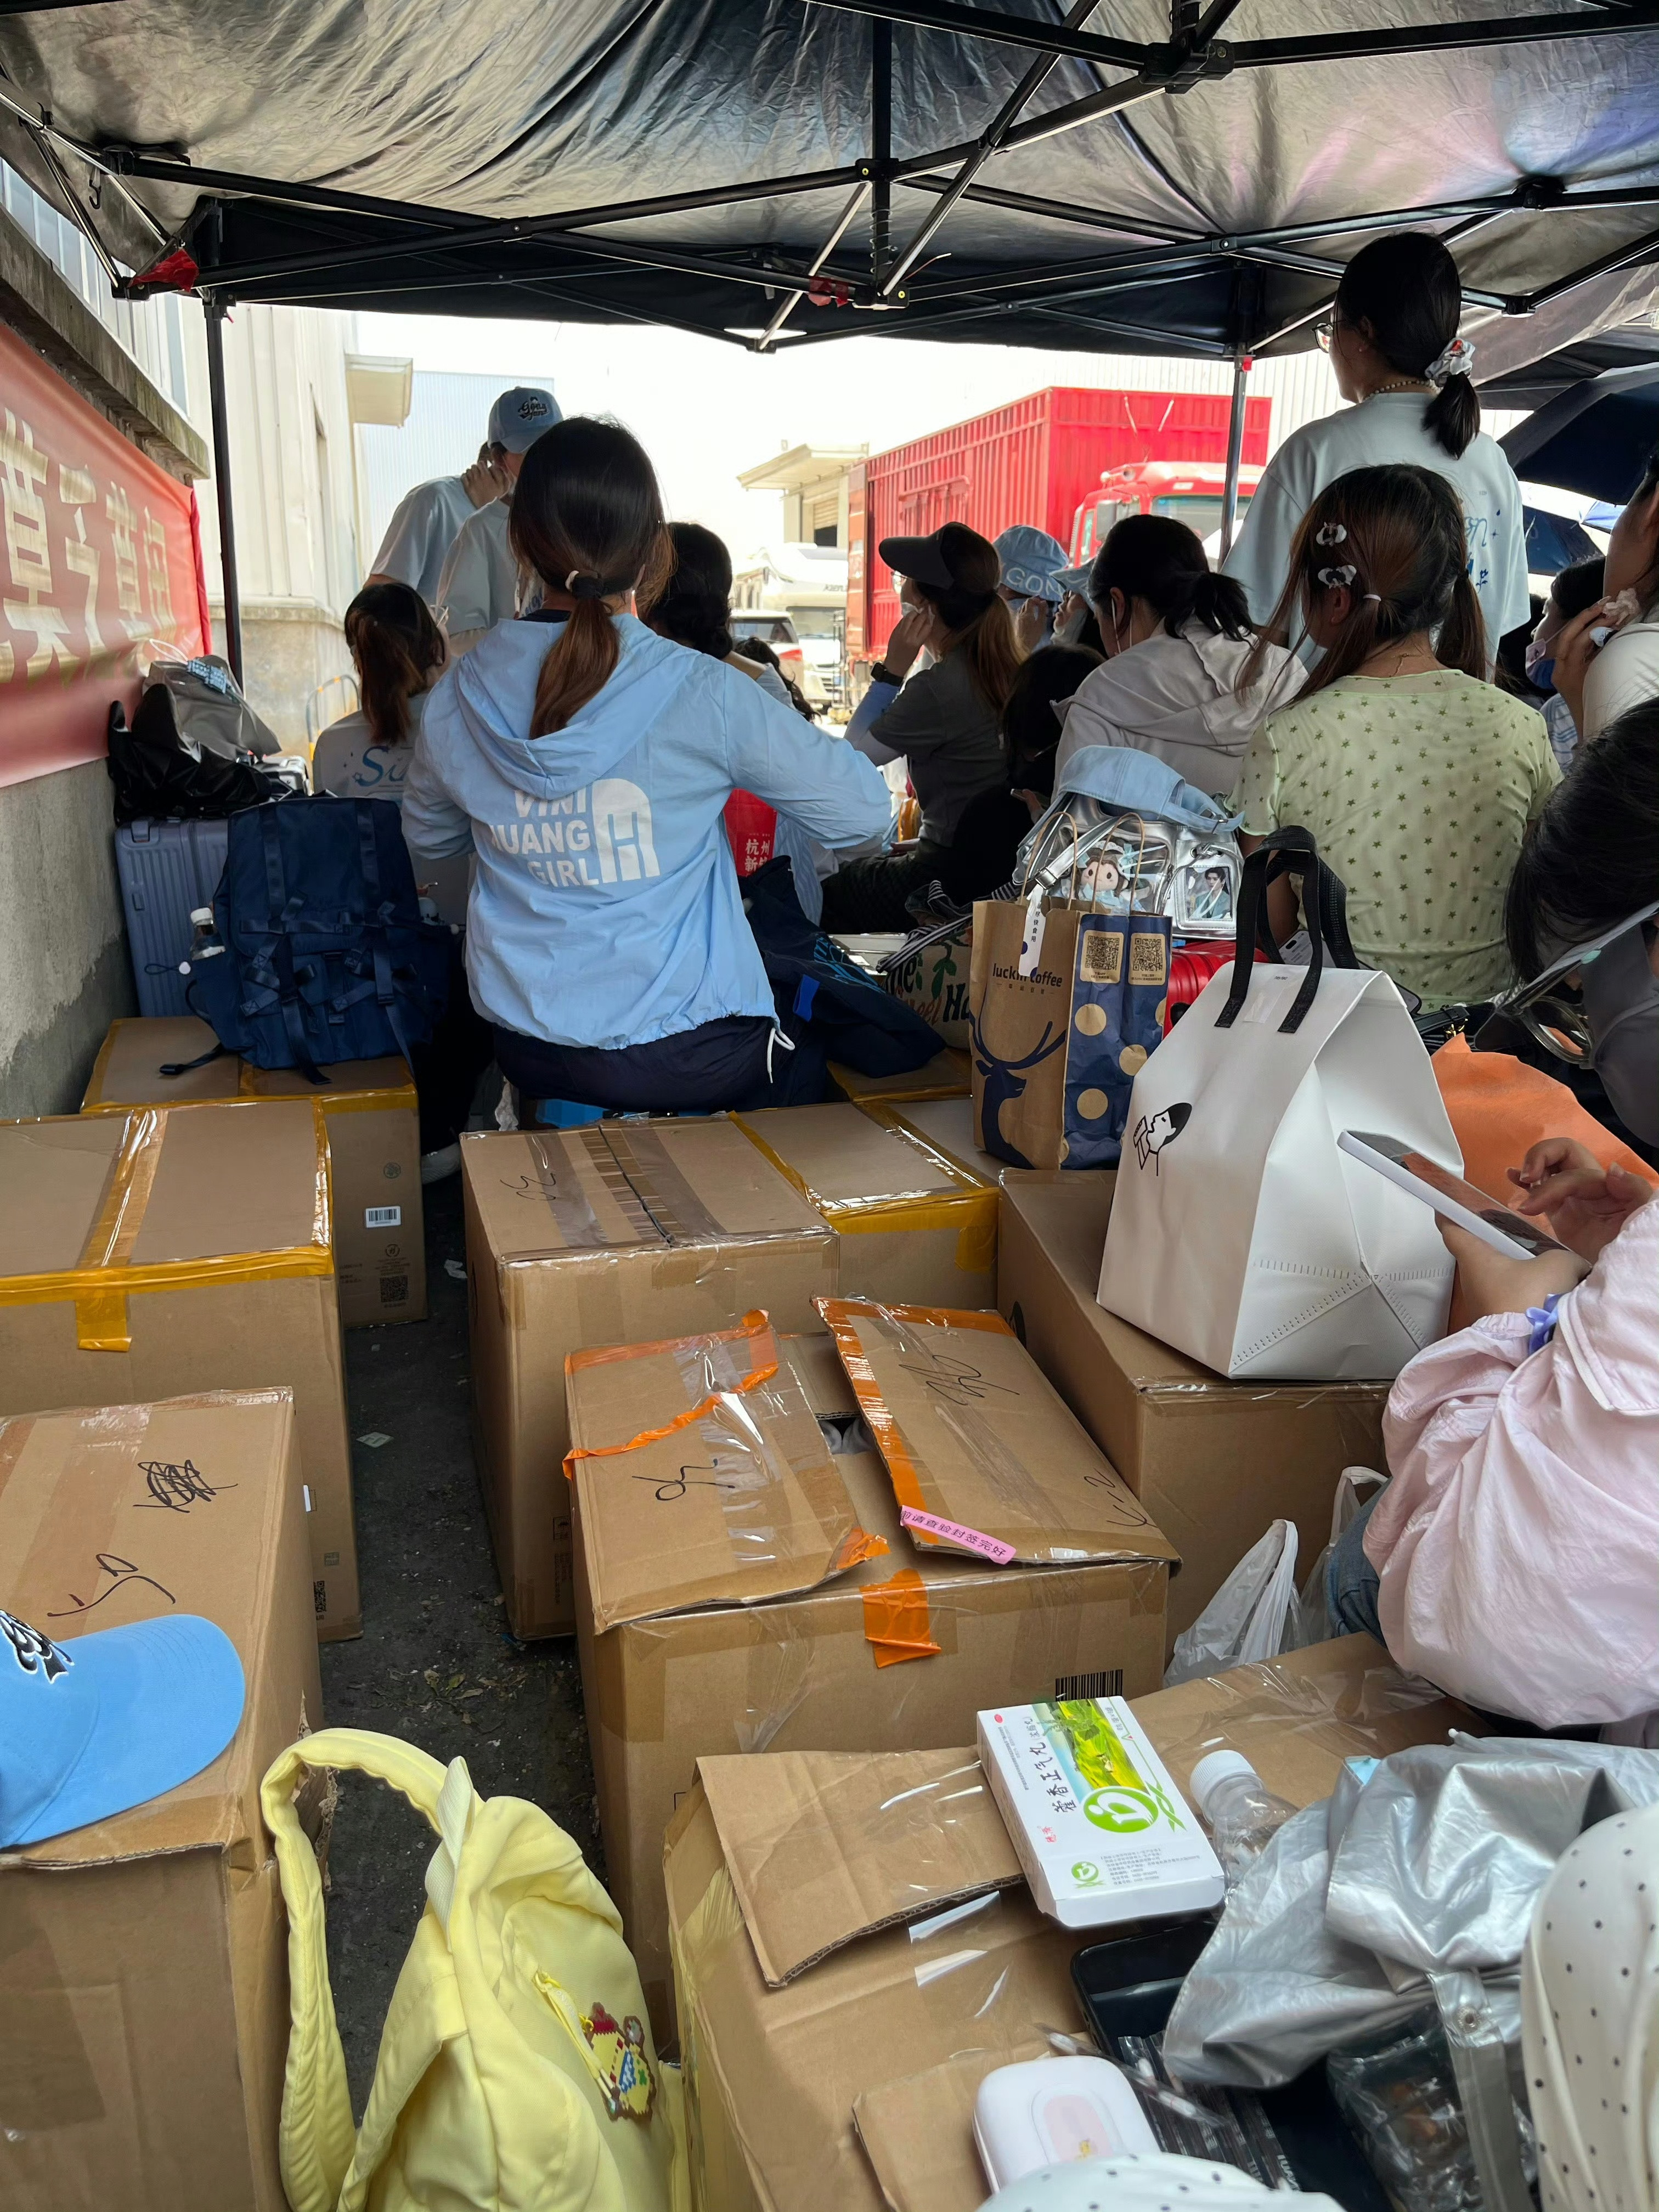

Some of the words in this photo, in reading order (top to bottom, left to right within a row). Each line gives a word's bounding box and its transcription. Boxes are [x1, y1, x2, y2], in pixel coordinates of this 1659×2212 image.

[745, 838, 770, 855] 杭州
[527, 858, 599, 887] GIRL
[1029, 1742, 1077, 1813] 藿香正气丸
